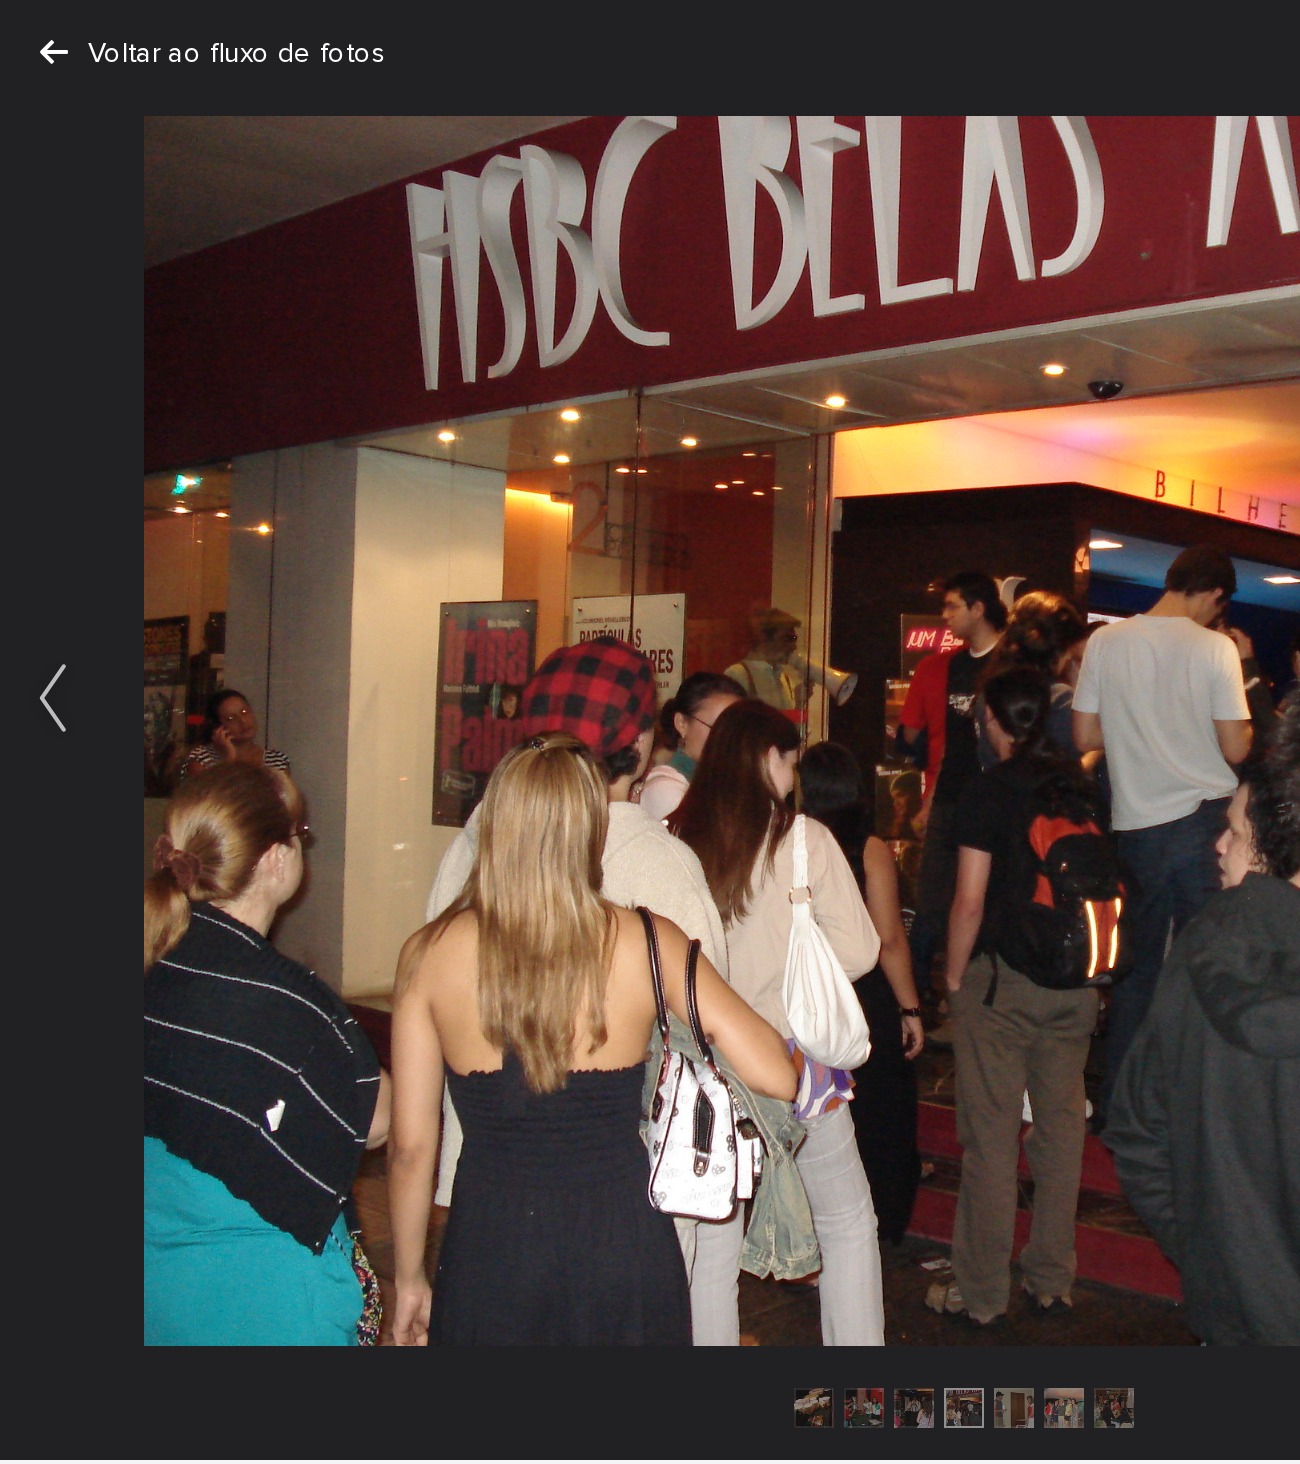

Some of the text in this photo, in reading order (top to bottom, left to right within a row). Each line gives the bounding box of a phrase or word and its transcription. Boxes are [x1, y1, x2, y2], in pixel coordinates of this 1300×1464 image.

[405, 116, 677, 391] HSBC
[718, 116, 1105, 331] BELAS
[443, 617, 529, 685] Irina
